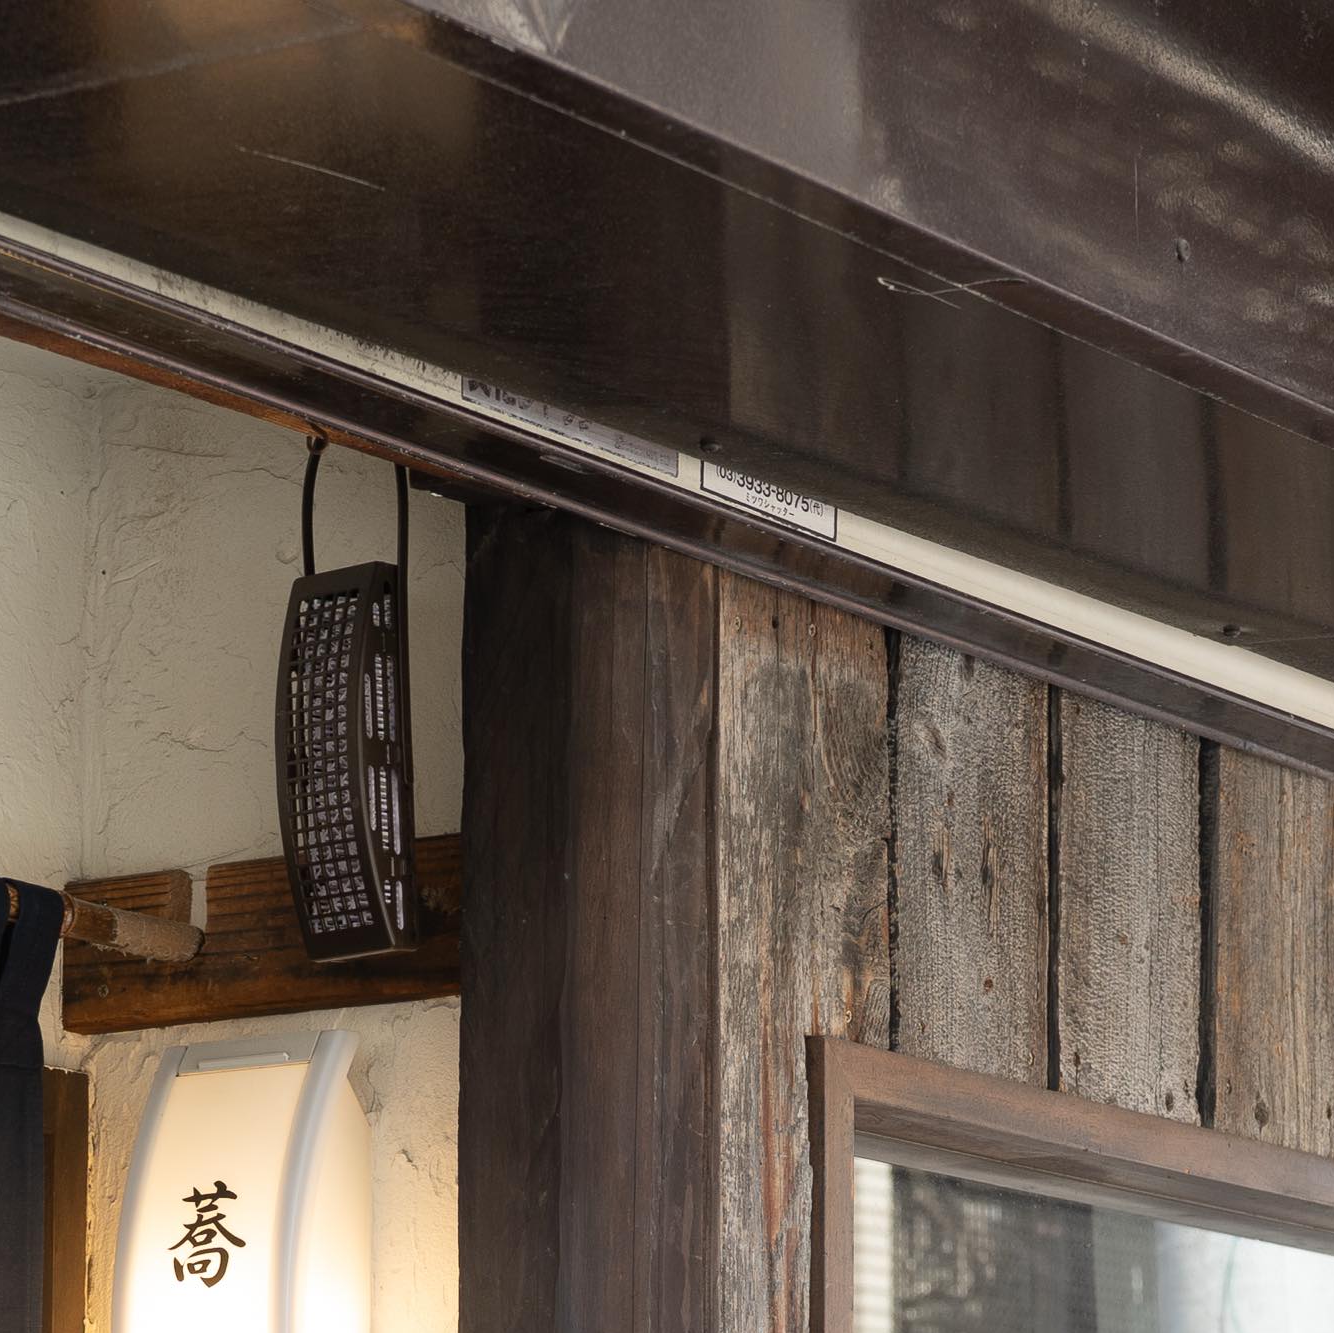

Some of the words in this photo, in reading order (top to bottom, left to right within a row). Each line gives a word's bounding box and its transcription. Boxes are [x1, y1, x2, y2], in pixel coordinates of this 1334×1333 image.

[745, 492, 795, 518] ミツワシャッター
